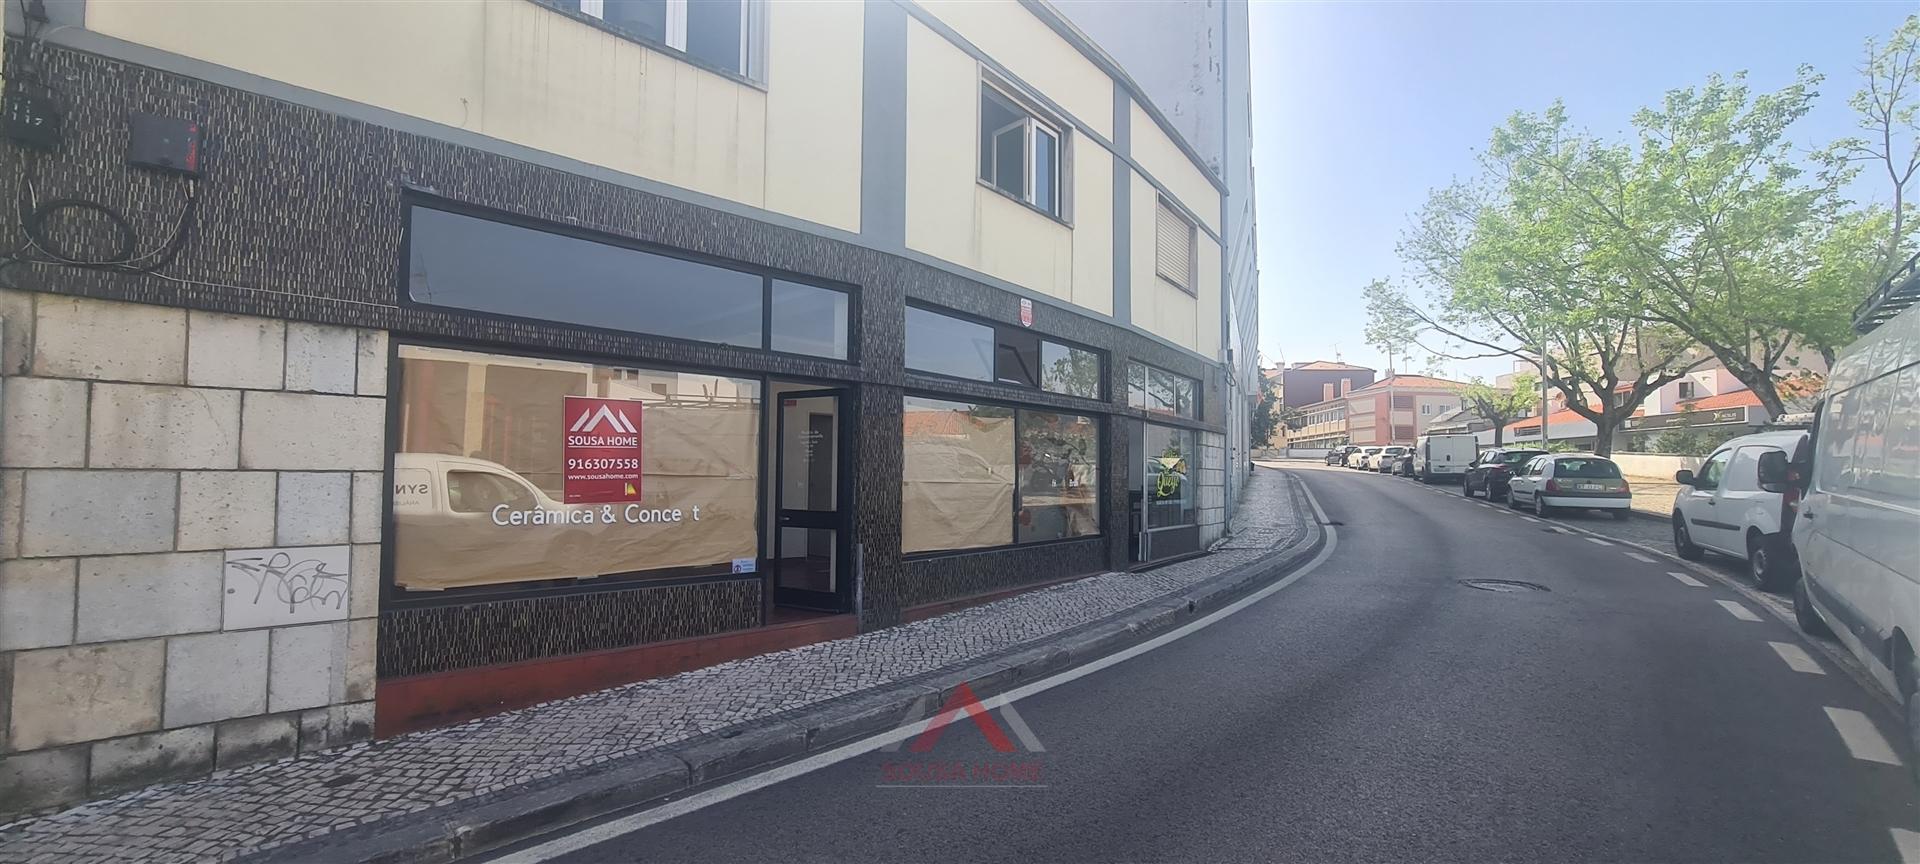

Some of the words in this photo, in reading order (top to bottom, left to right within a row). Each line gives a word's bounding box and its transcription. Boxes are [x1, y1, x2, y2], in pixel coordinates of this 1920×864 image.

[568, 435, 605, 446] SOUSA
[607, 436, 638, 446] HOME
[568, 458, 639, 470] 916307558
[567, 472, 639, 480] www.sousahome.com
[491, 503, 595, 526] Cerâmica
[601, 504, 617, 524] &
